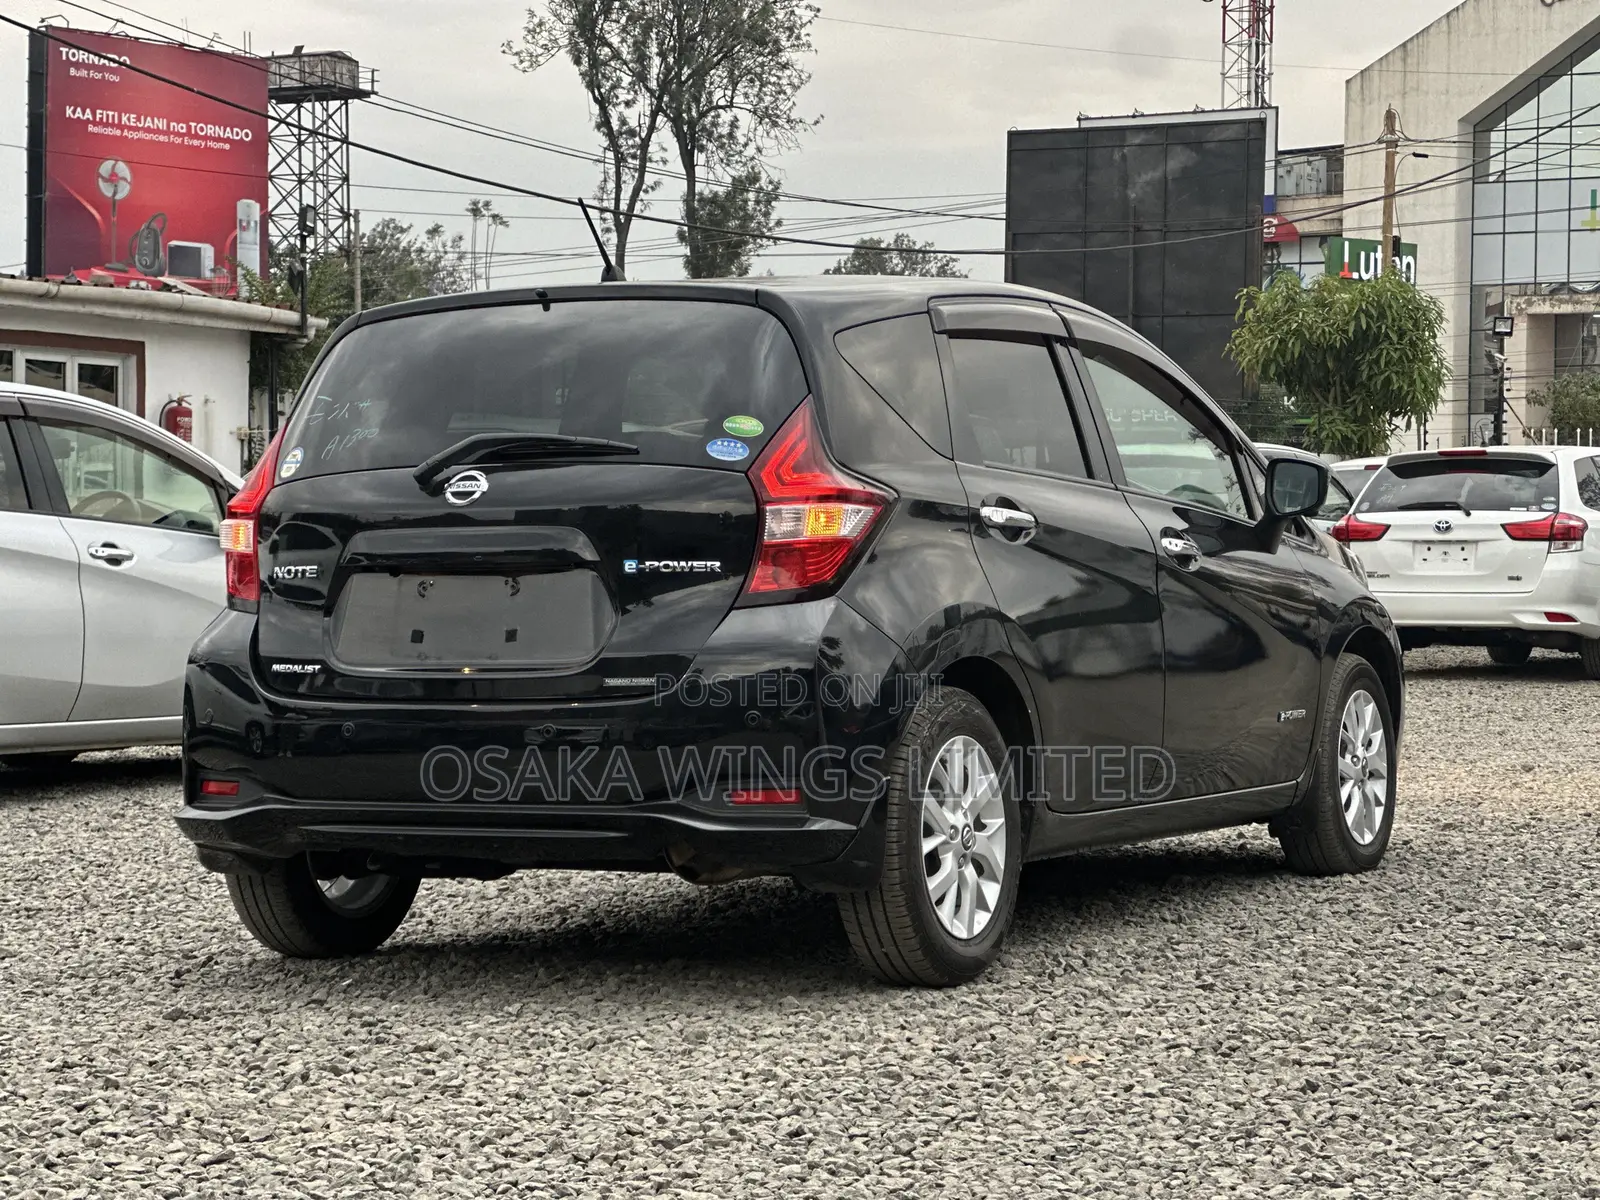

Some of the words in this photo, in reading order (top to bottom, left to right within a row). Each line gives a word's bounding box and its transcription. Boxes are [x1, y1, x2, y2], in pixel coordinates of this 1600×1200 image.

[59, 47, 130, 68] TORNADO
[69, 67, 88, 78] Built
[89, 70, 103, 79] For
[104, 72, 120, 82] You
[65, 105, 93, 121] KAA
[95, 109, 118, 124] FITI
[121, 112, 167, 130] KEJANI
[170, 121, 186, 133] na
[189, 122, 252, 142] TORNADO
[88, 124, 122, 136] Reliable
[122, 129, 169, 142] Appliances
[170, 135, 183, 144] For
[184, 137, 206, 149] Every
[207, 140, 230, 150] Home
[273, 565, 318, 579] NOTE
[623, 560, 721, 573] e-POWER
[271, 664, 321, 673] MEDALIST
